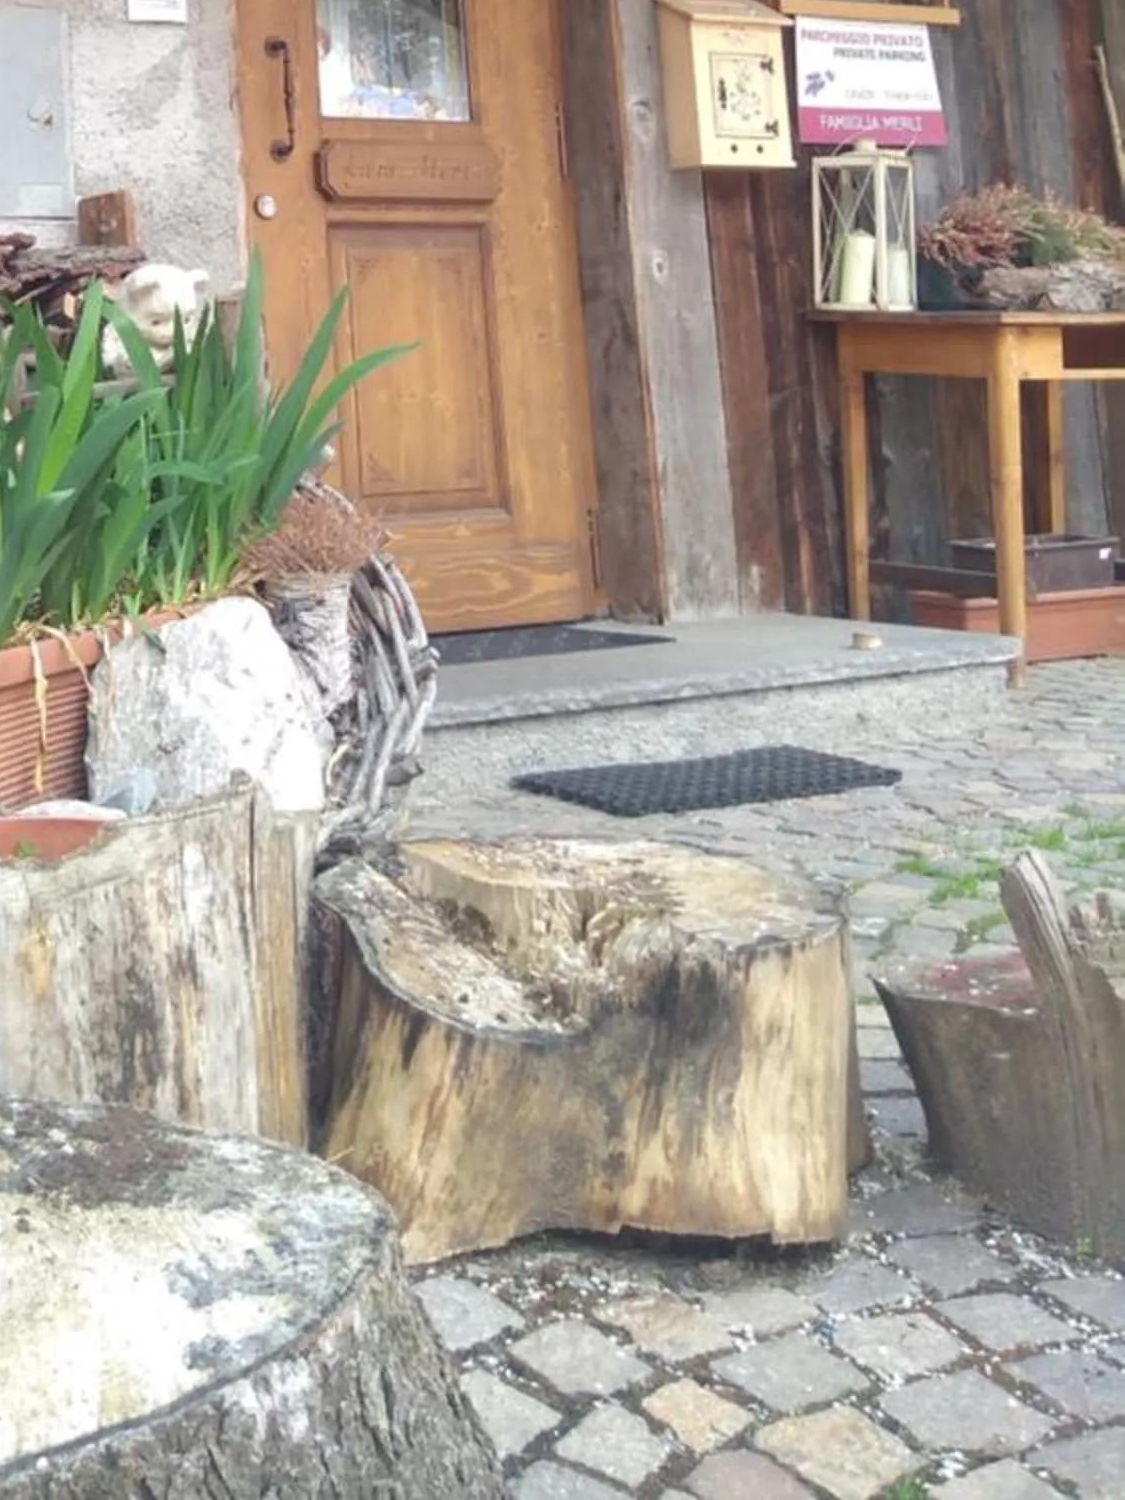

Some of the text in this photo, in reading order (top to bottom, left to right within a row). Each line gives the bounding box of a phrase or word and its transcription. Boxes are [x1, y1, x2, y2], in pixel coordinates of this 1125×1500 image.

[800, 28, 923, 48] PARCHEGGIO PRIVATO
[833, 47, 926, 62] PRIVATE PARKING
[819, 114, 879, 130] FAMIGLIA
